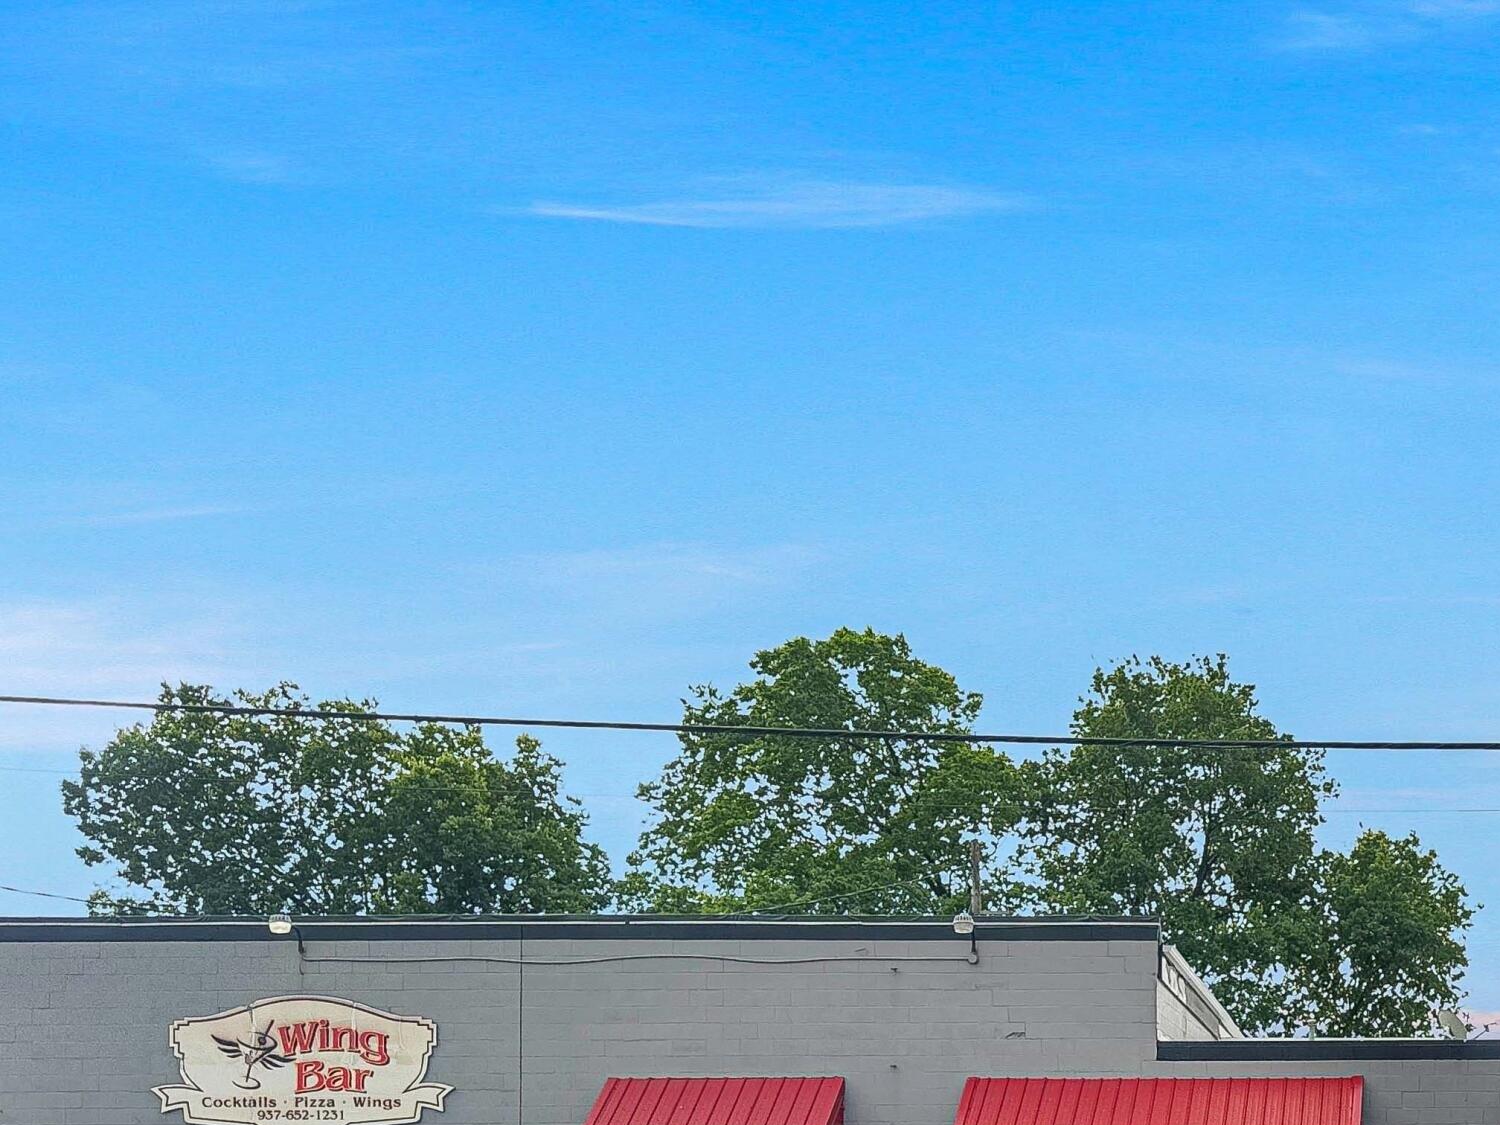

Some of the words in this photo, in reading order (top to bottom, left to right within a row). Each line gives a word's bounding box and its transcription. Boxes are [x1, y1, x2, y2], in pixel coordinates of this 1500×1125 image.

[277, 1019, 390, 1066] Wing
[294, 1060, 374, 1094] Bar
[201, 1096, 277, 1109] Cocktails
[294, 1096, 336, 1109] Pizza
[353, 1096, 401, 1110] Wings
[256, 1109, 345, 1121] 937-652-1231
